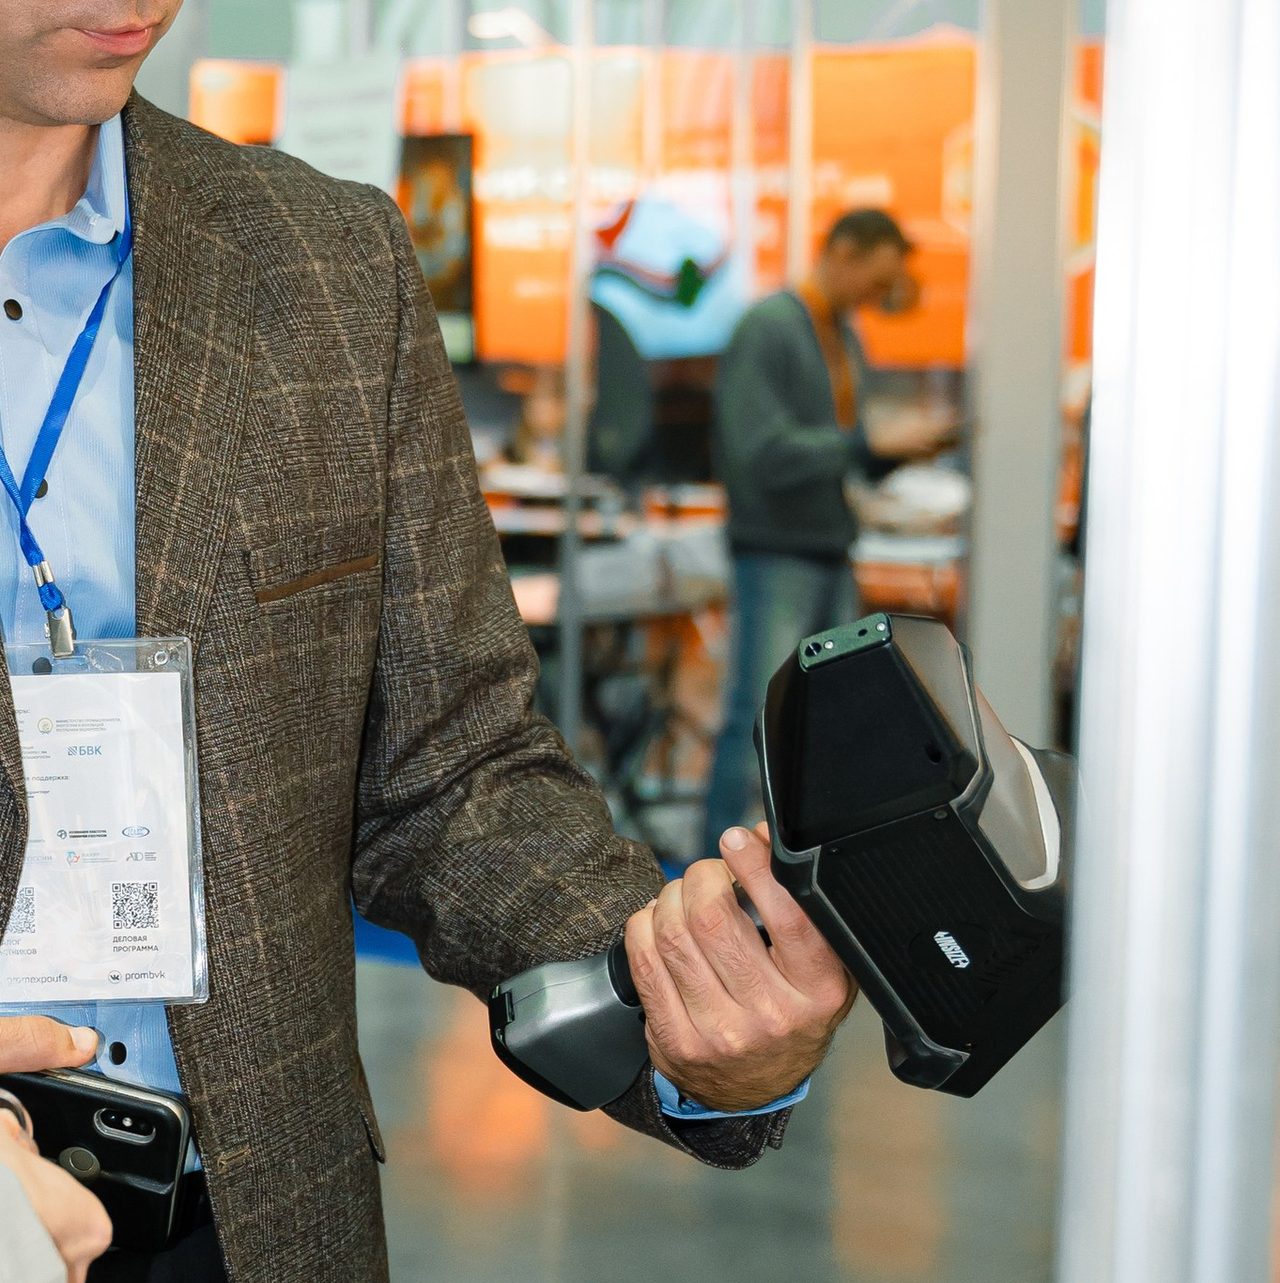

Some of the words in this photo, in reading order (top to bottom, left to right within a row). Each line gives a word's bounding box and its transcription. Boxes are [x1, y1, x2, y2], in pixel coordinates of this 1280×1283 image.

[79, 746, 102, 756] БВК
[112, 935, 148, 943] ДЕЛОВАЯ
[125, 970, 166, 982] prombvk
